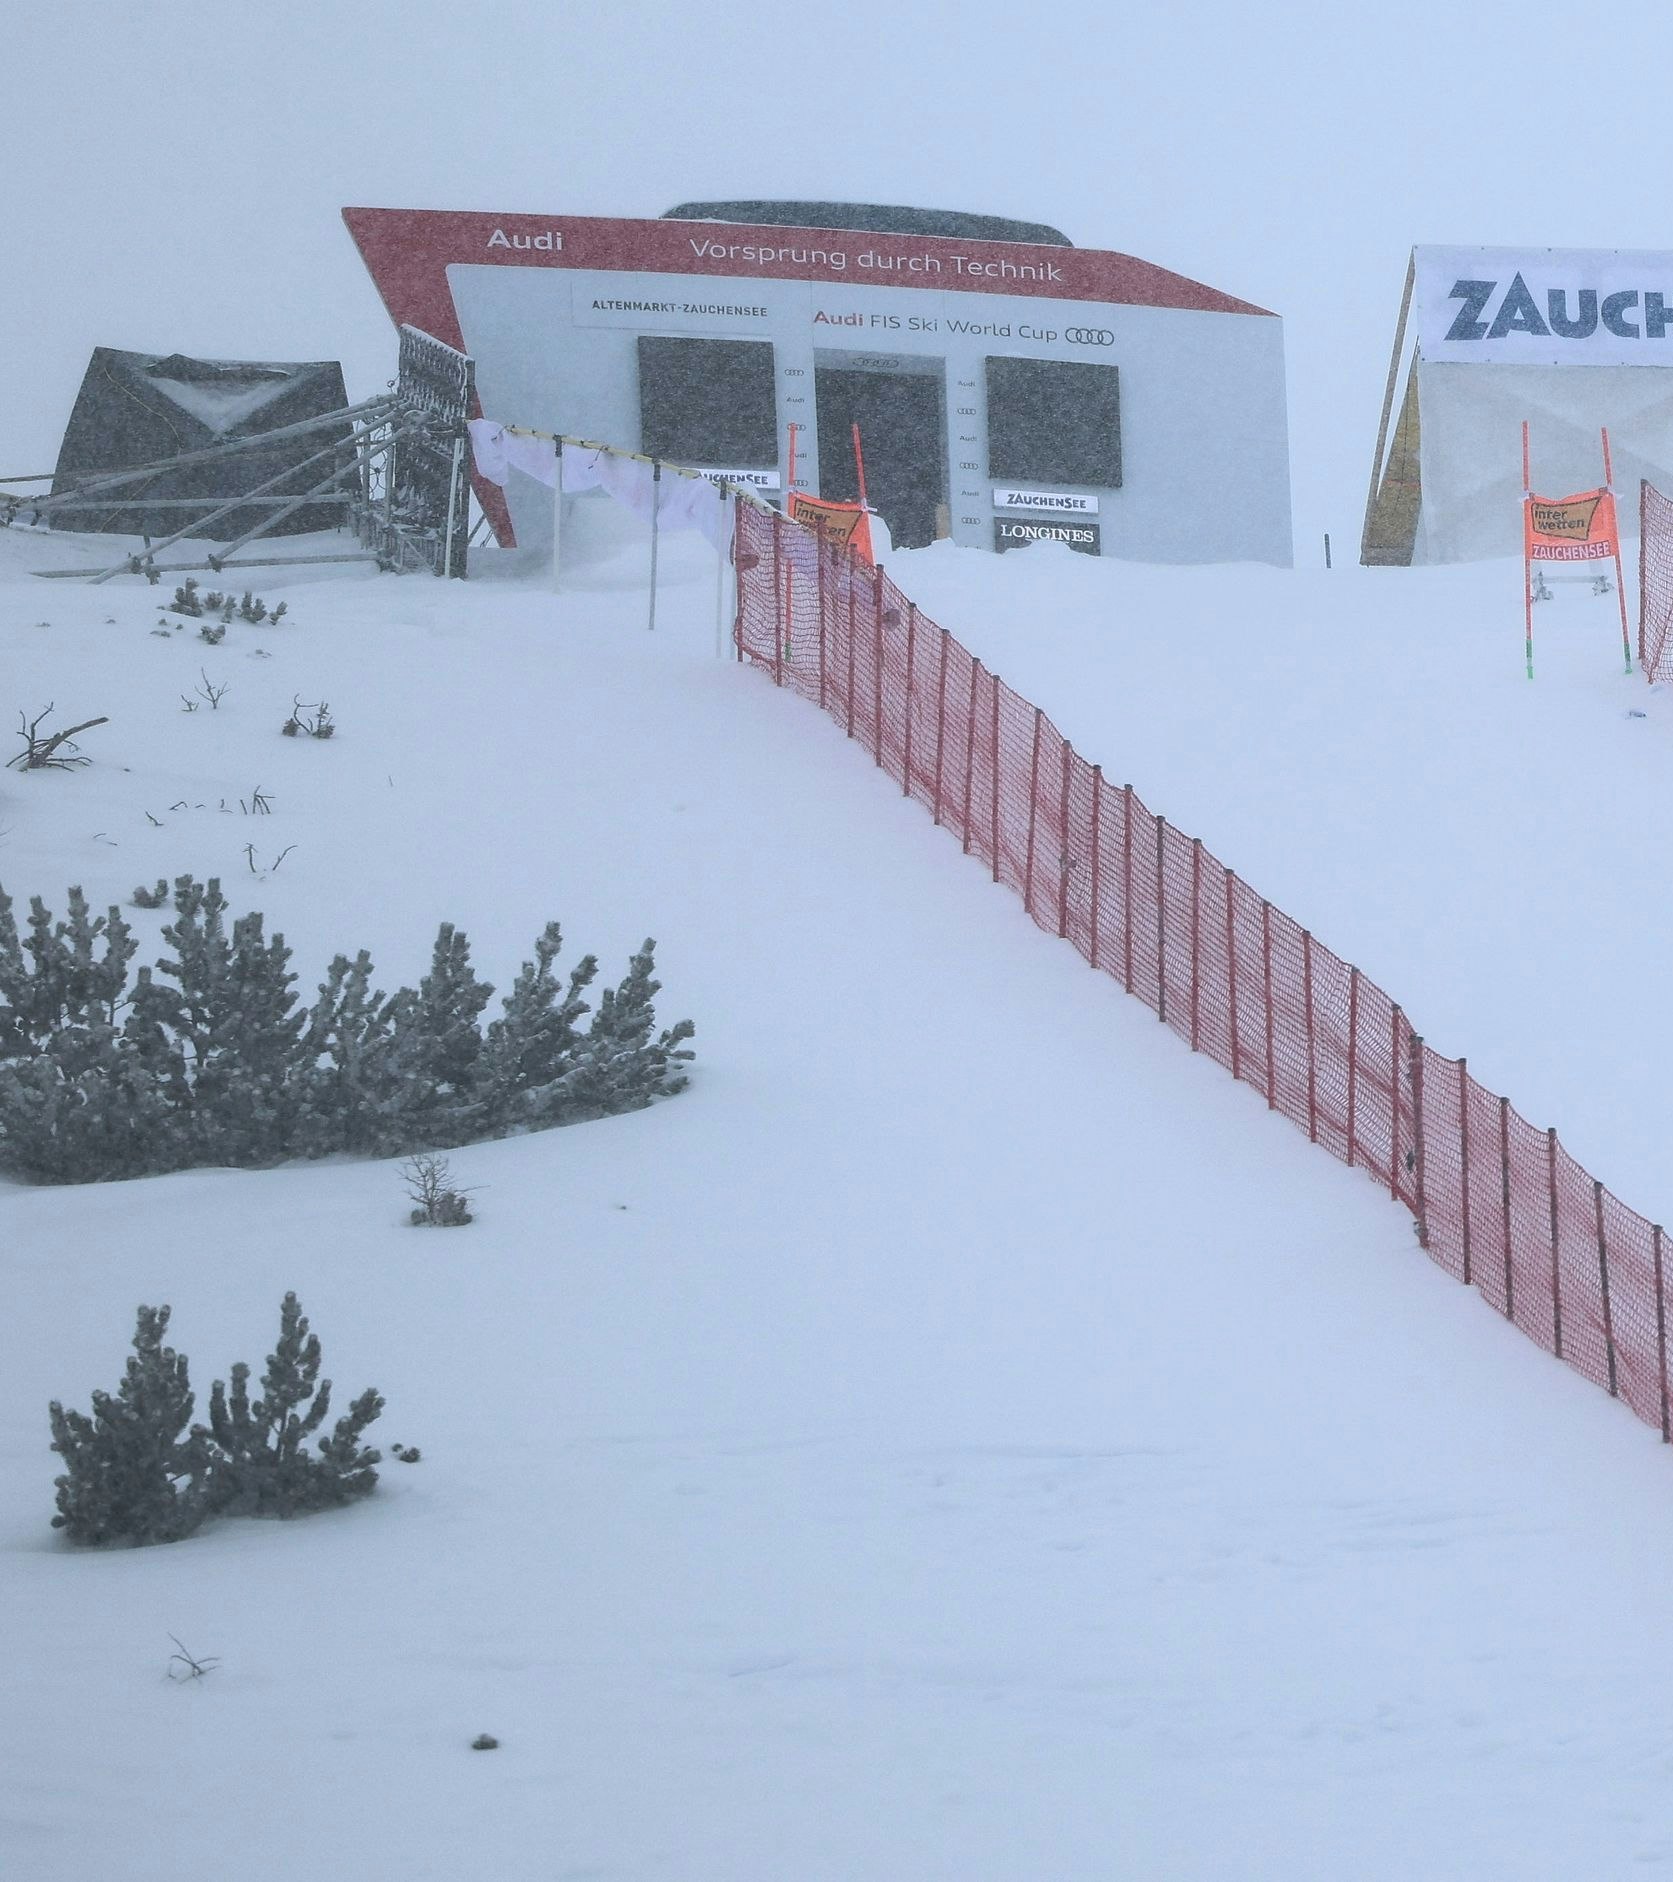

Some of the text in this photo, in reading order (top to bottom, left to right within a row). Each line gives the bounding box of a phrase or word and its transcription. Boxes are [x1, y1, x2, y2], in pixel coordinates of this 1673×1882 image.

[487, 229, 565, 251] Audi
[690, 238, 1064, 282] Vorsprung durch Technik
[591, 299, 768, 318] ALTENMARKT-ZAUCHENSEE
[813, 310, 1058, 344] Audi FIS Ski World Cup
[1534, 503, 1568, 520] inter
[1000, 524, 1095, 543] LONGINES
[1538, 518, 1585, 530] wetten
[1533, 541, 1610, 560] ZAUCHENSEE
